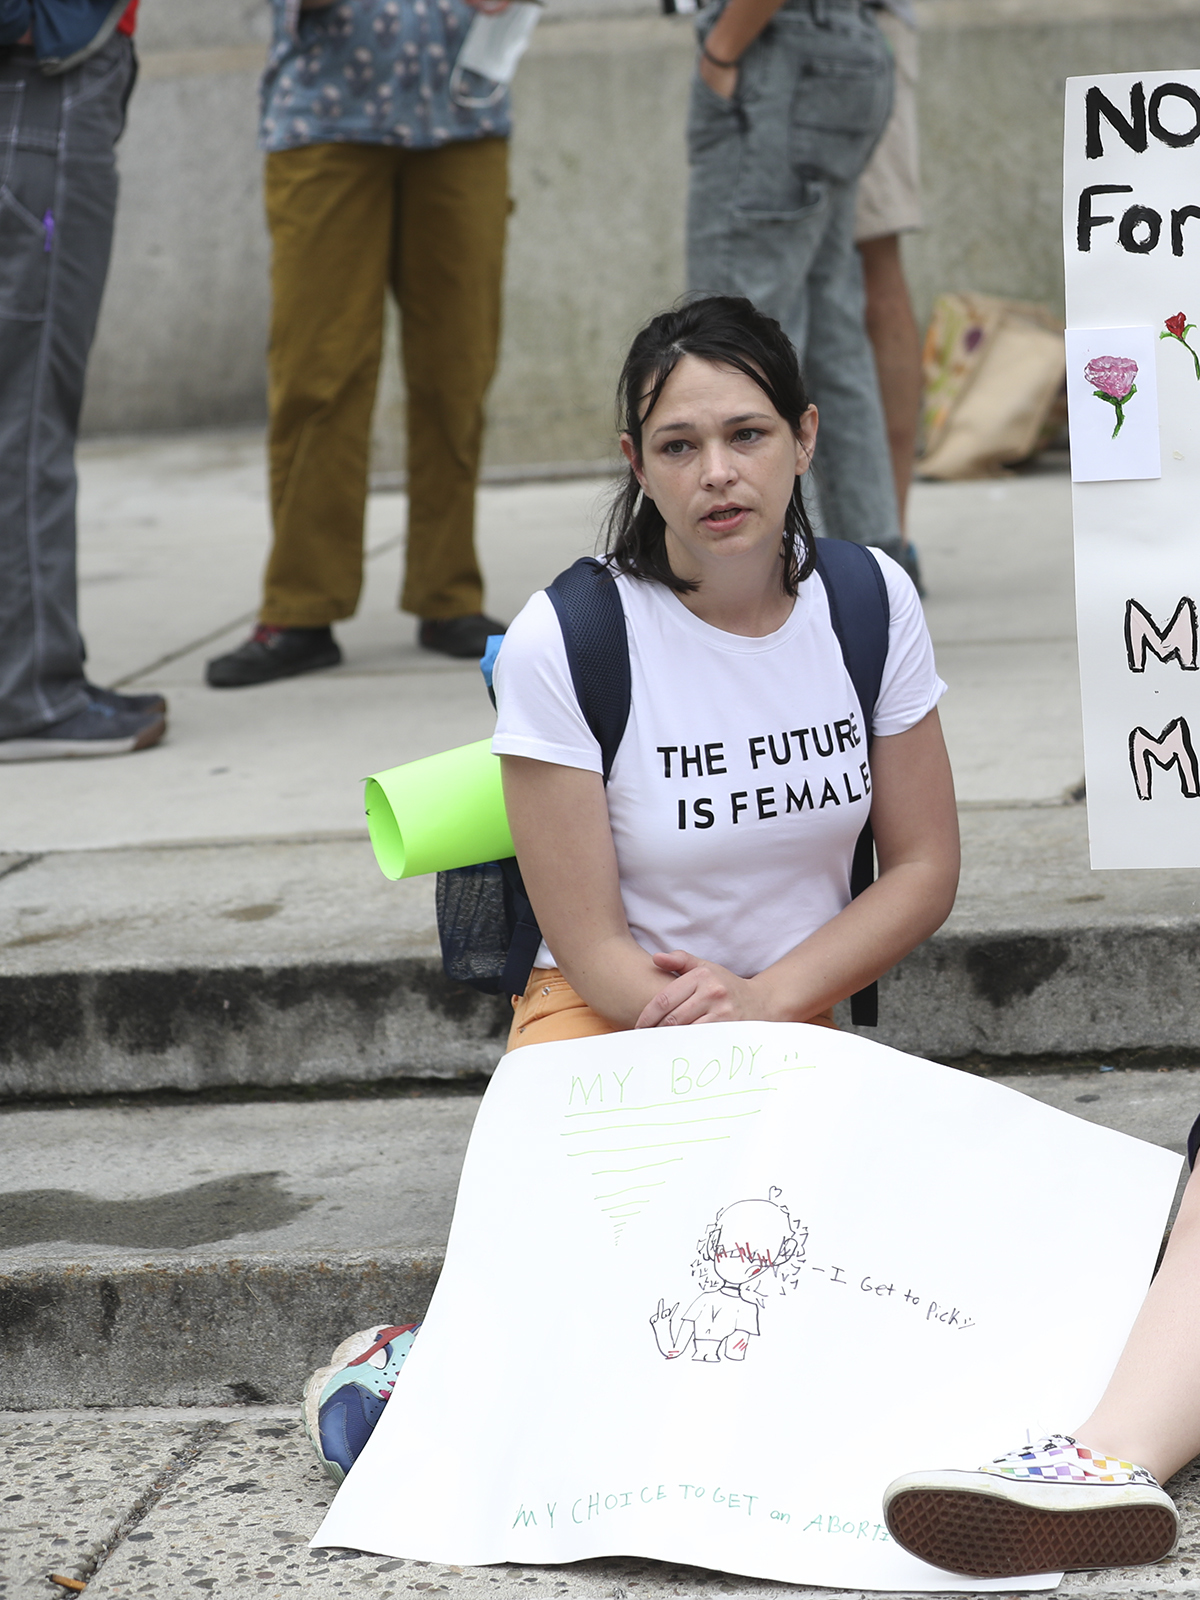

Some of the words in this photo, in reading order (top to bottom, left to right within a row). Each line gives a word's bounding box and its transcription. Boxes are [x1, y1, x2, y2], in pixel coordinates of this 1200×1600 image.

[656, 742, 728, 778] THE
[748, 712, 861, 770] FUTURE
[677, 797, 715, 830] IS
[730, 761, 872, 825] FEMALE
[568, 1065, 635, 1106] MY
[670, 1044, 764, 1096] BODY
[859, 1275, 897, 1297] Get
[903, 1288, 920, 1306] to
[511, 1502, 558, 1530] MY
[571, 1484, 668, 1525] CHOICE
[678, 1484, 706, 1500] TO
[712, 1486, 760, 1517] GET
[769, 1509, 792, 1525] an
[802, 1513, 890, 1542] ABORTI
